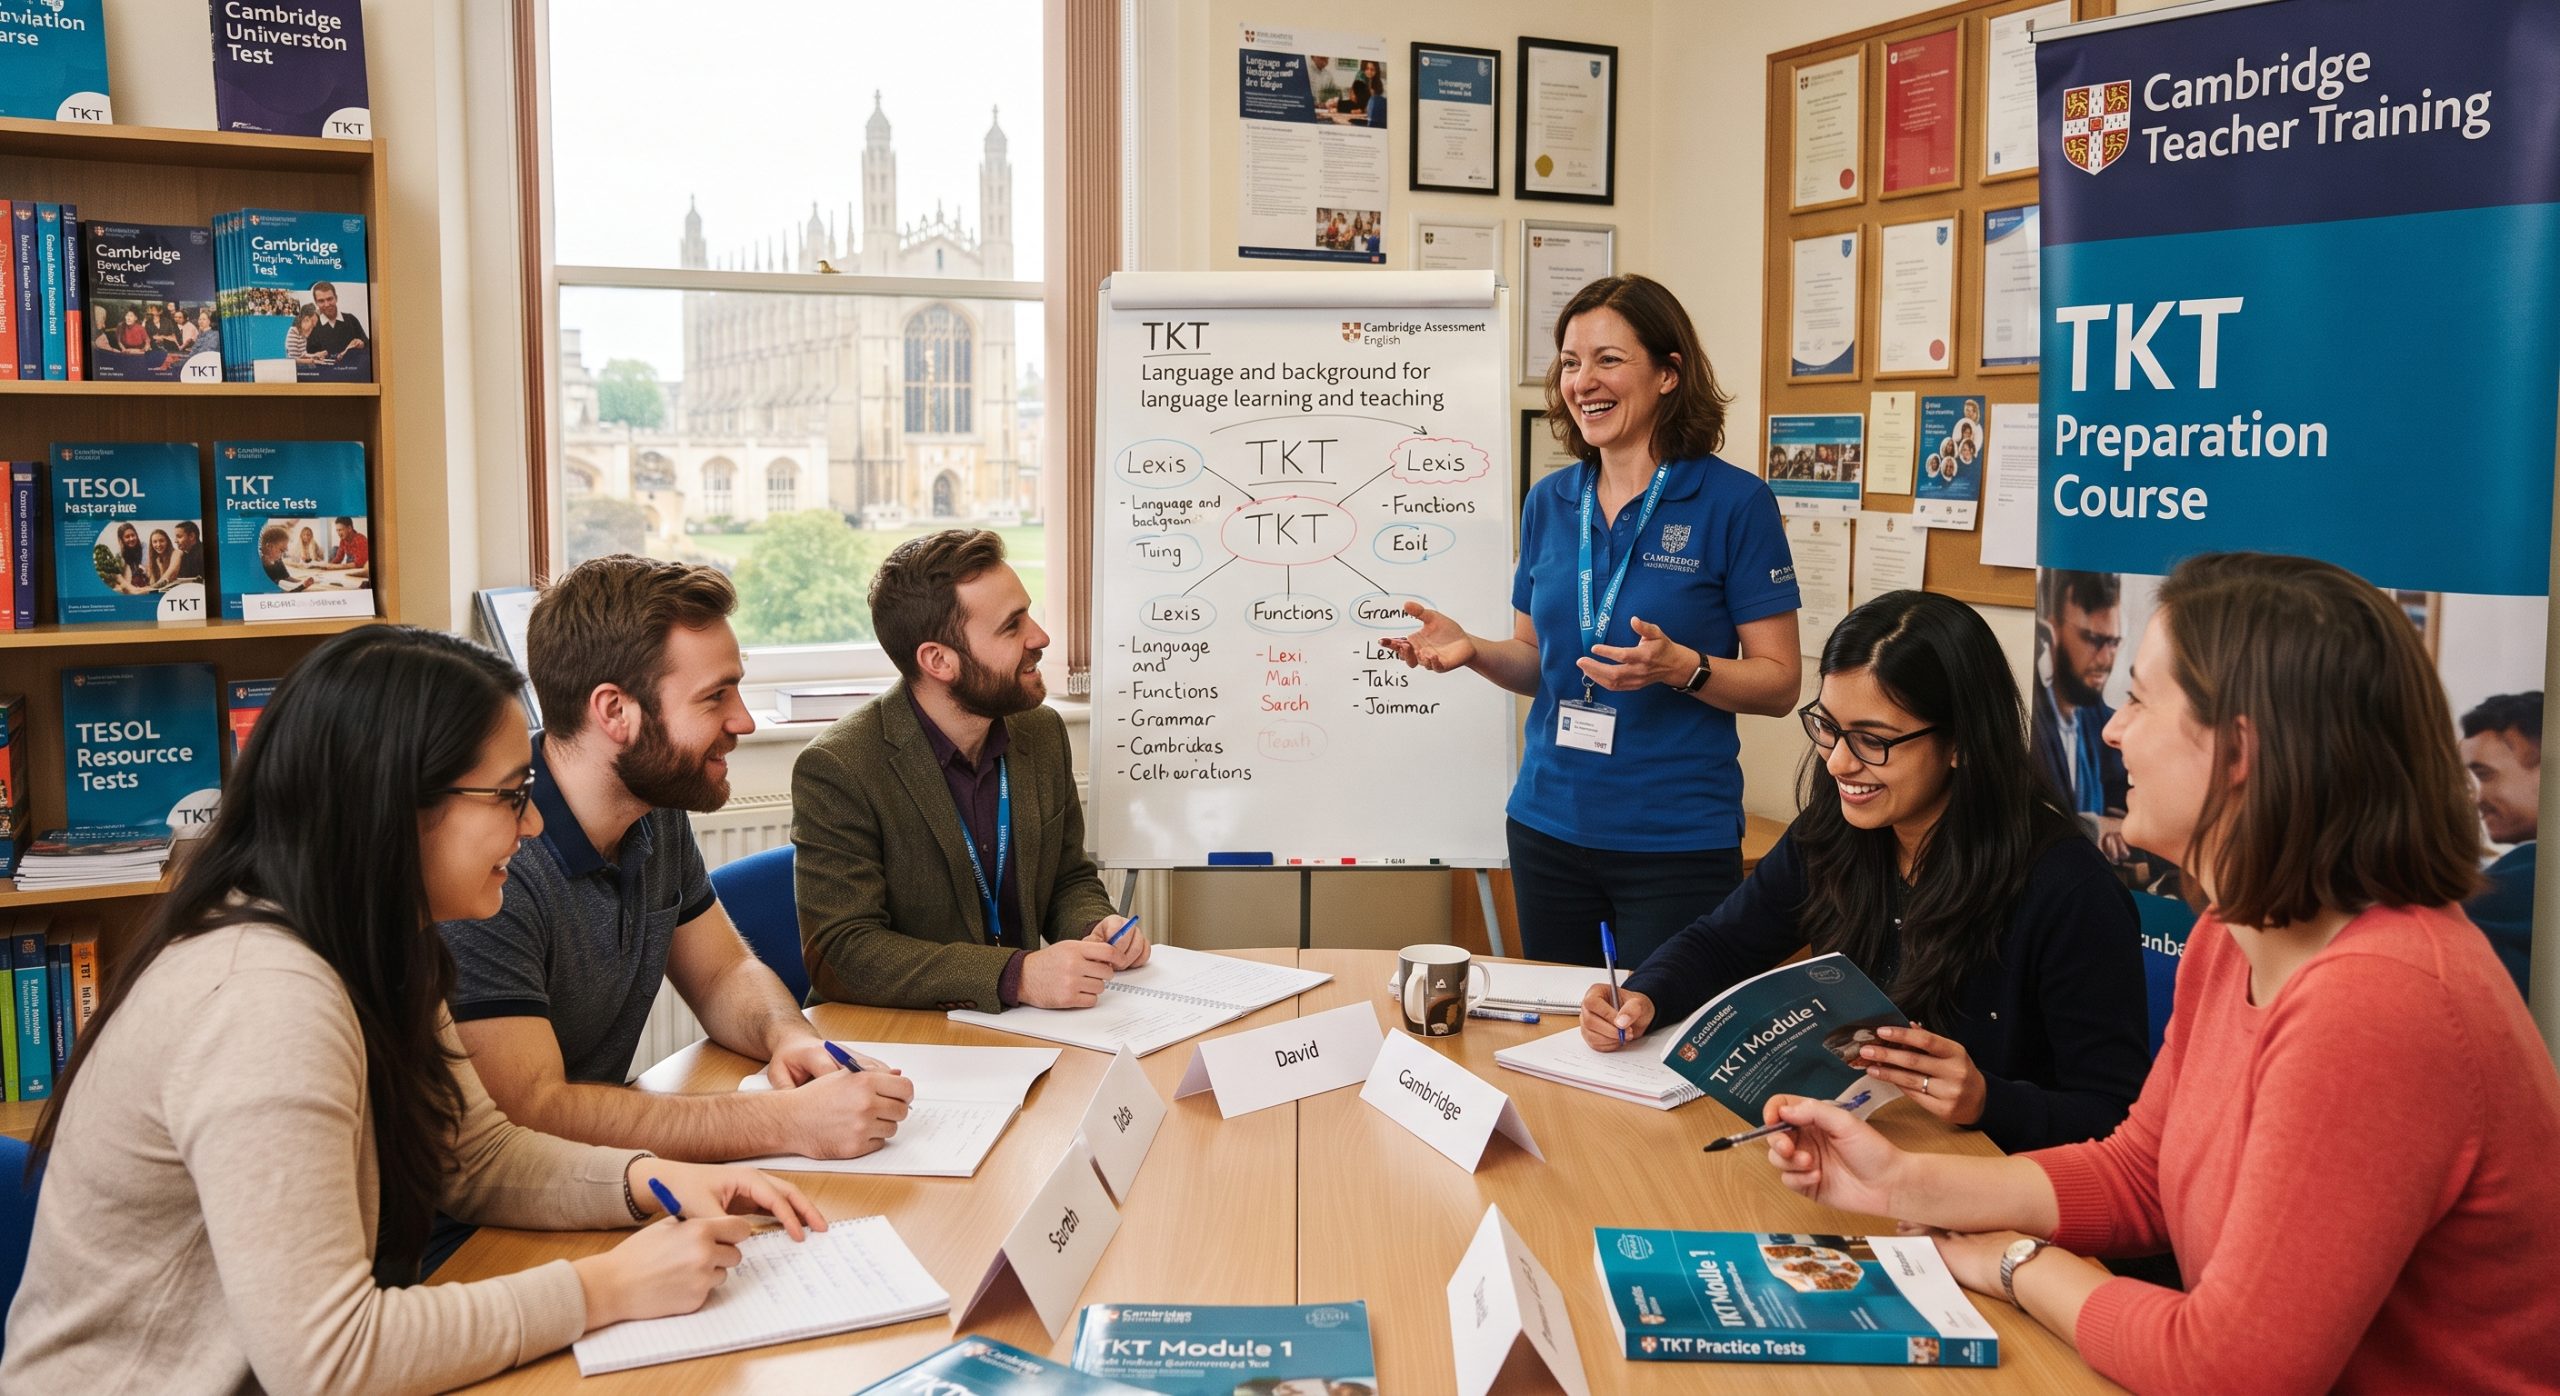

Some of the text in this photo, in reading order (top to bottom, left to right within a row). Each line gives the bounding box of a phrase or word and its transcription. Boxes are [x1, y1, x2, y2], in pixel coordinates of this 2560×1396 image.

[225, 1, 342, 33] Cambridge
[227, 43, 274, 65] Test
[2143, 46, 2371, 112] Cambridge
[68, 106, 103, 121] TKT
[332, 121, 364, 135] TKT
[2143, 89, 2492, 164] Teacher Training
[96, 244, 181, 265] Cambridge
[252, 237, 338, 257] Cambridge
[97, 271, 126, 284] Test
[253, 264, 278, 276] Test
[1142, 322, 1210, 351] TKT
[1364, 321, 1486, 335] Cambridge Assessment
[1364, 335, 1401, 347] English
[2056, 296, 2244, 392] TKT
[190, 365, 217, 377] TKT
[1142, 361, 1431, 385] Language and background for
[1141, 389, 1445, 412] language learning and teaching
[2056, 410, 2328, 471] Preparation
[1127, 451, 1187, 475] Lexis
[1245, 439, 1338, 475] TKT
[1407, 449, 1466, 472] Lexis
[62, 478, 145, 498] TESOL
[225, 475, 274, 495] TKT
[226, 497, 317, 511] Practice Tests
[1132, 495, 1221, 515] Language and
[1393, 495, 1475, 514] Functions
[2054, 473, 2208, 521] Course
[1245, 513, 1328, 545] TKT
[166, 598, 201, 612] TKT
[1152, 602, 1200, 621] Lexis
[1254, 601, 1333, 621] Functions
[1132, 635, 1210, 662] Language
[1132, 657, 1166, 672] and
[1362, 670, 1409, 687] Takis
[1133, 681, 1218, 699] Functions
[1261, 694, 1309, 711] Sarch
[1365, 696, 1440, 714] Joimmar
[1131, 709, 1215, 726] Grammar
[75, 720, 160, 743] TESOL
[77, 746, 193, 768] Resourcce
[77, 770, 139, 792] Tests
[177, 807, 218, 825] TKT
[1709, 1047, 1747, 1086] TKT
[1744, 1006, 1814, 1055] Module
[1812, 998, 1827, 1011] 1
[1275, 1040, 1319, 1067] David
[1399, 1069, 1462, 1121] Cambridge
[1097, 1339, 1292, 1357] TKT Module 1
[1661, 1338, 1806, 1356] TKT Practice Tests
